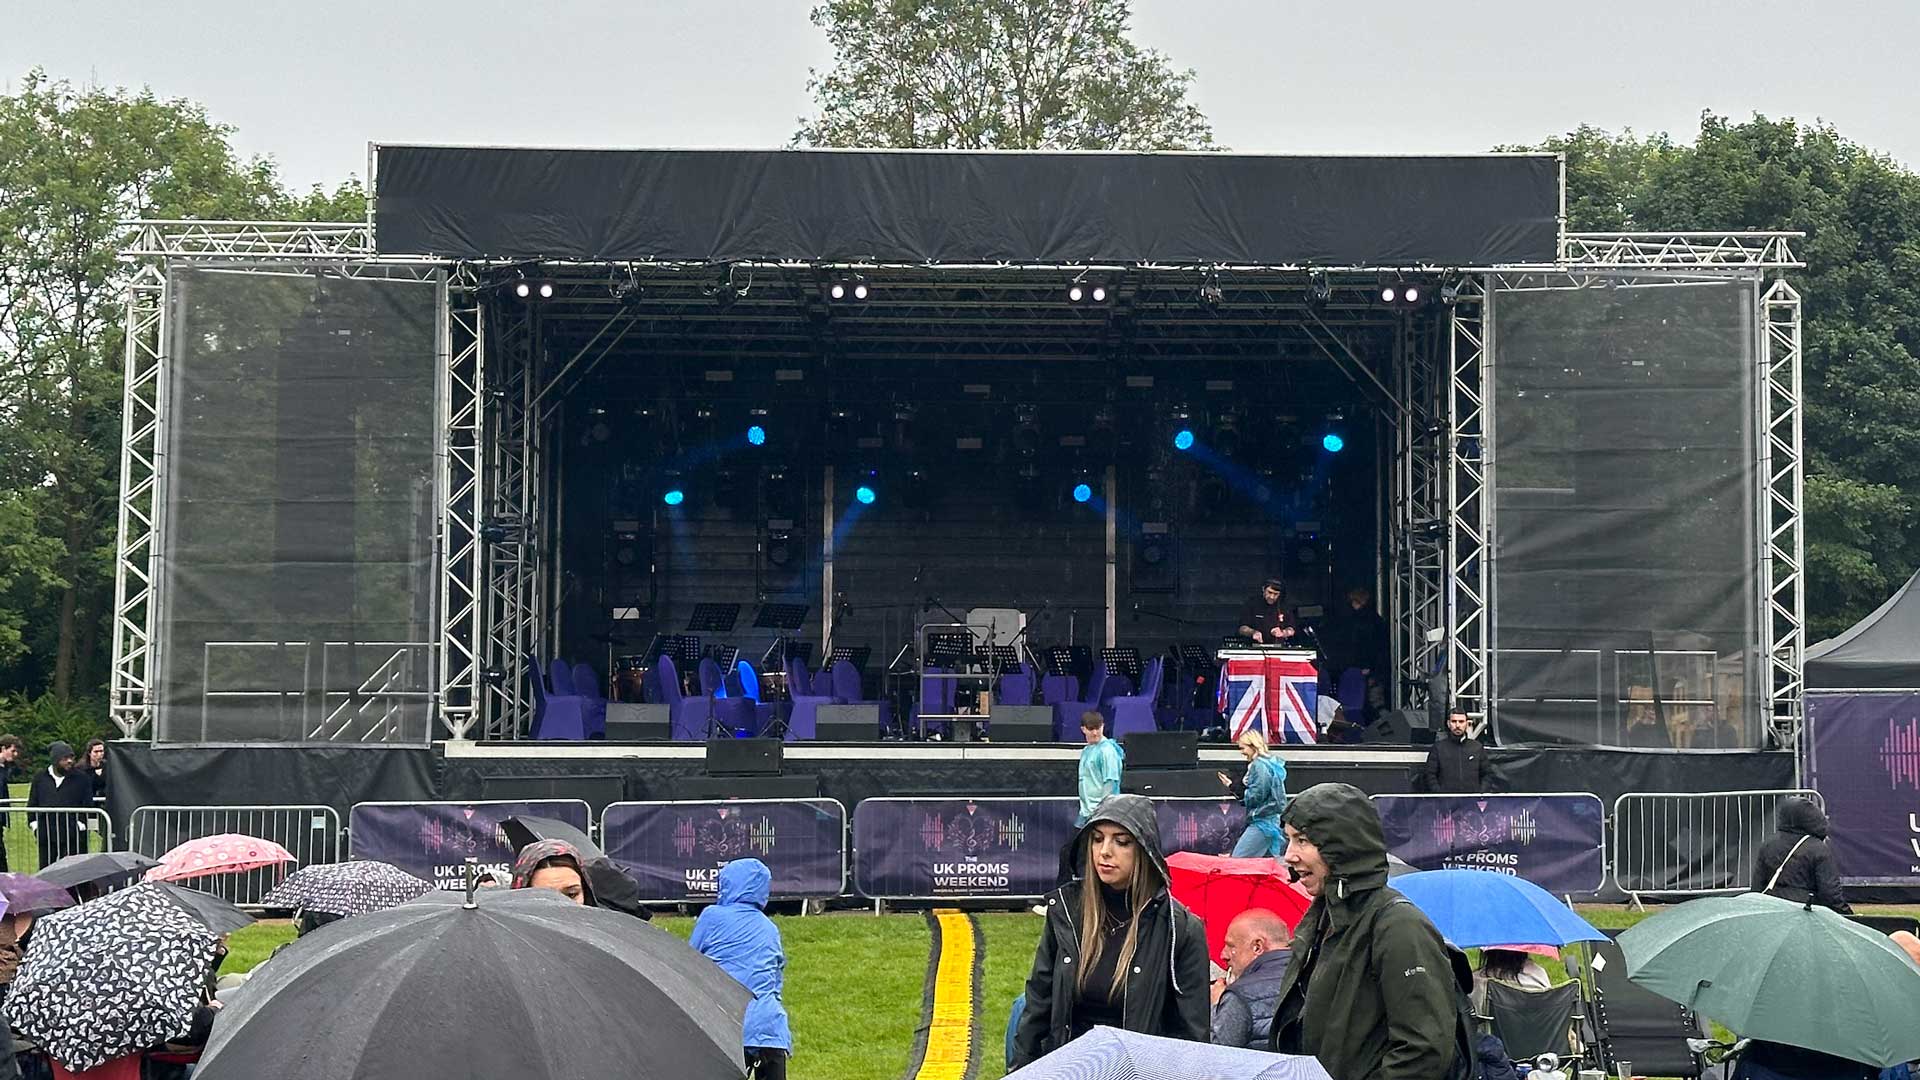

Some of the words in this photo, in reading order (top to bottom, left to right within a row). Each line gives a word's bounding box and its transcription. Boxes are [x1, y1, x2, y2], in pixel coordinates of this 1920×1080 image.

[1466, 853, 1518, 865] PROMS
[434, 865, 456, 877] UK
[933, 863, 955, 874] UK
[957, 863, 1010, 874] PROMS
[685, 869, 707, 880] UK
[934, 876, 1009, 887] WEEKEND
